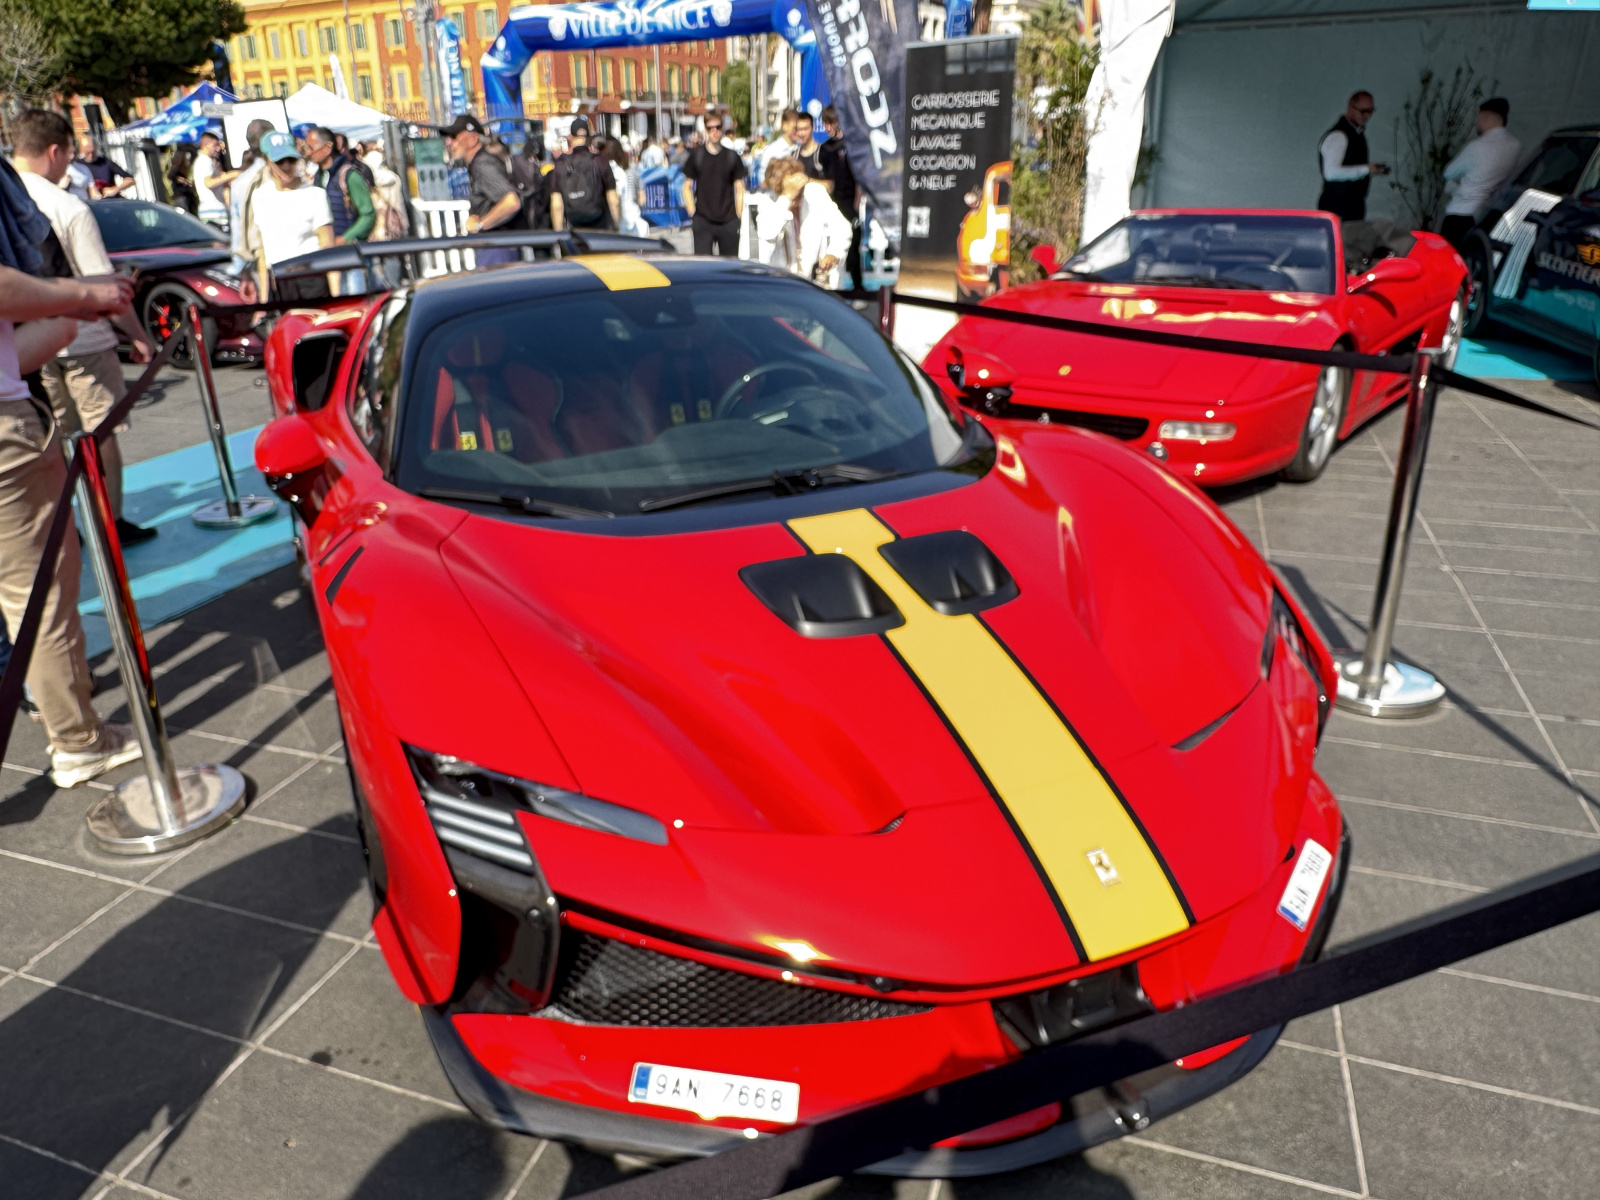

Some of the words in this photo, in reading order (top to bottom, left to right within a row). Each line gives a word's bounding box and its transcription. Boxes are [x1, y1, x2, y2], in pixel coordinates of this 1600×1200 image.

[568, 11, 622, 39] VILLE
[655, 5, 710, 33] NICE
[911, 89, 1000, 110] CARROSSERIE
[911, 134, 962, 150] LAVAGE
[909, 154, 976, 170] OCCASION
[920, 174, 957, 190] NEUF
[722, 1082, 783, 1112] 7668
